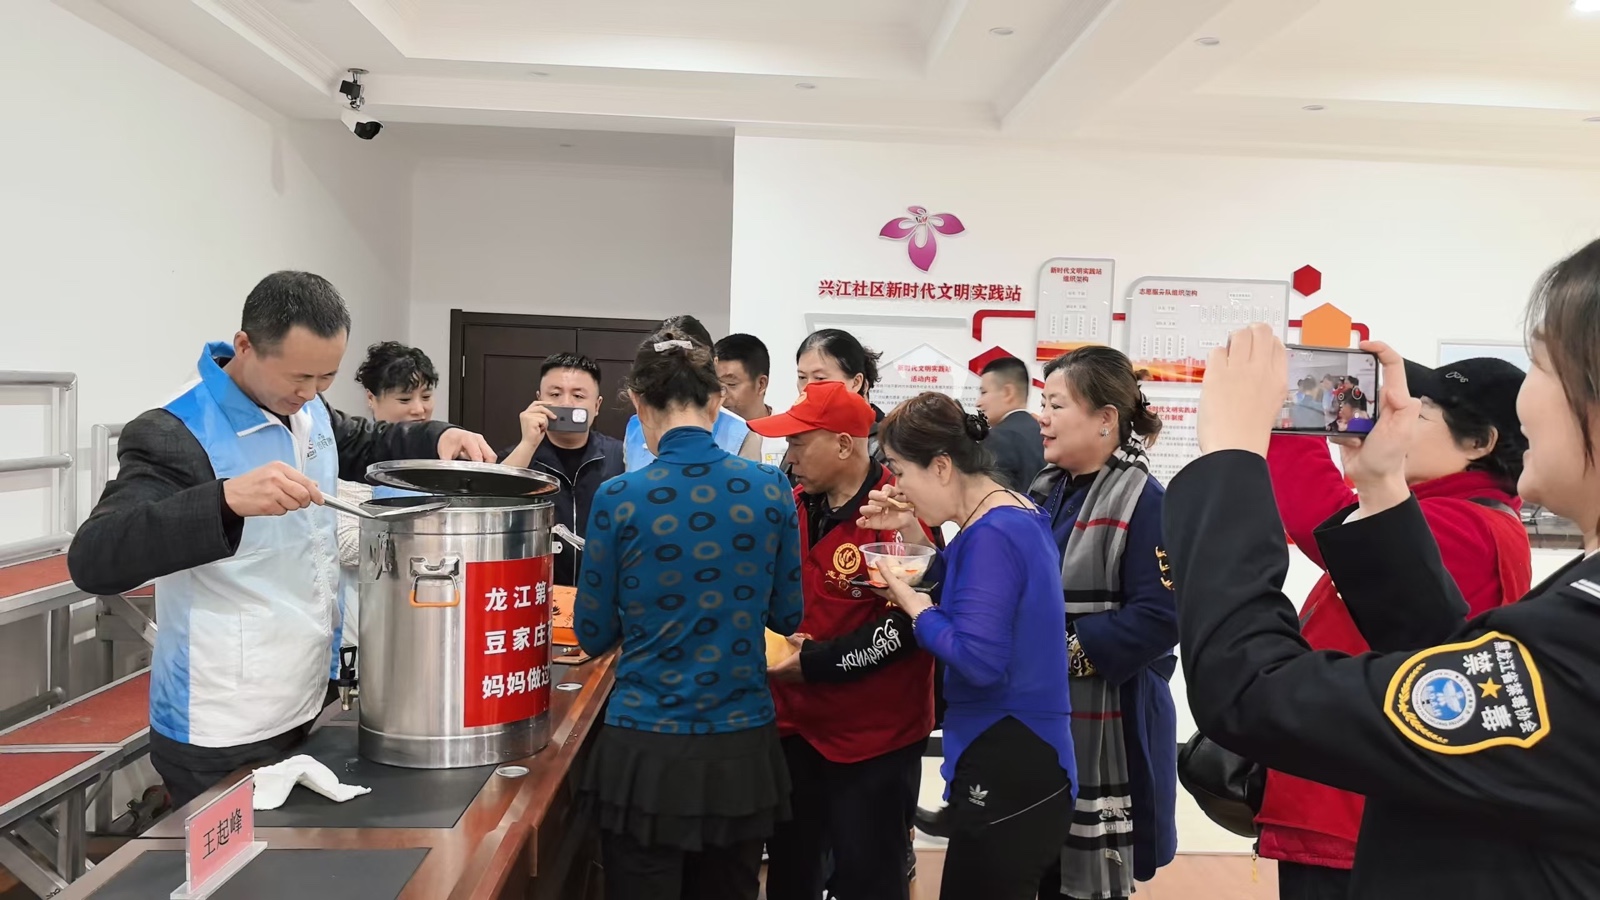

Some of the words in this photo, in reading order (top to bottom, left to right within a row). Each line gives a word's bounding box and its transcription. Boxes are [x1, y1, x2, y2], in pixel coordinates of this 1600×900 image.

[1050, 266, 1103, 275] 新时代文明实践站
[818, 279, 1022, 302] 兴江社区新时代文明实践站
[1139, 288, 1198, 297] 志愿服务队组织架构
[910, 375, 938, 383] 活动内容
[1463, 651, 1494, 675] 禁
[1481, 705, 1513, 731] 毒
[1493, 641, 1538, 733] 黑龙江省禁毒协会
[202, 808, 243, 860] 王起峰
